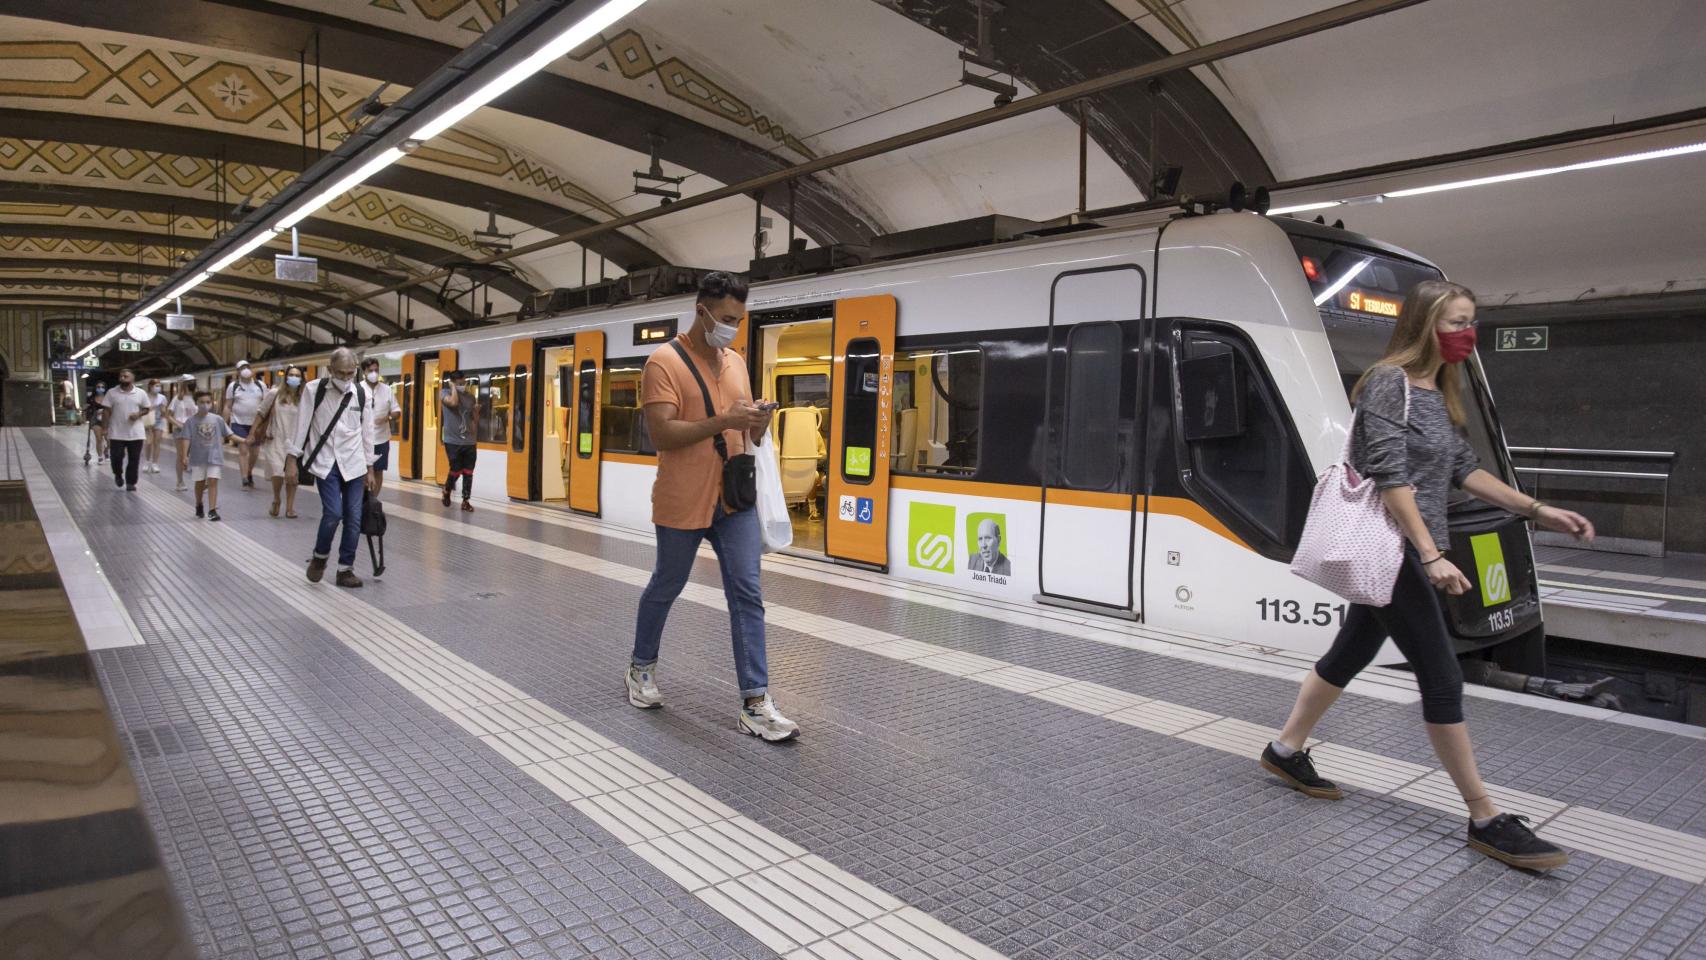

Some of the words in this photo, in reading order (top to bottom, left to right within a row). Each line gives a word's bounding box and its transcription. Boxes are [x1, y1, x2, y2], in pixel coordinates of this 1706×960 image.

[1363, 298, 1397, 316] TERRASSA
[972, 572, 986, 582] Joan
[988, 575, 1007, 585] Triadú
[1255, 598, 1345, 627] 113.51
[1488, 608, 1513, 632] 113.51
